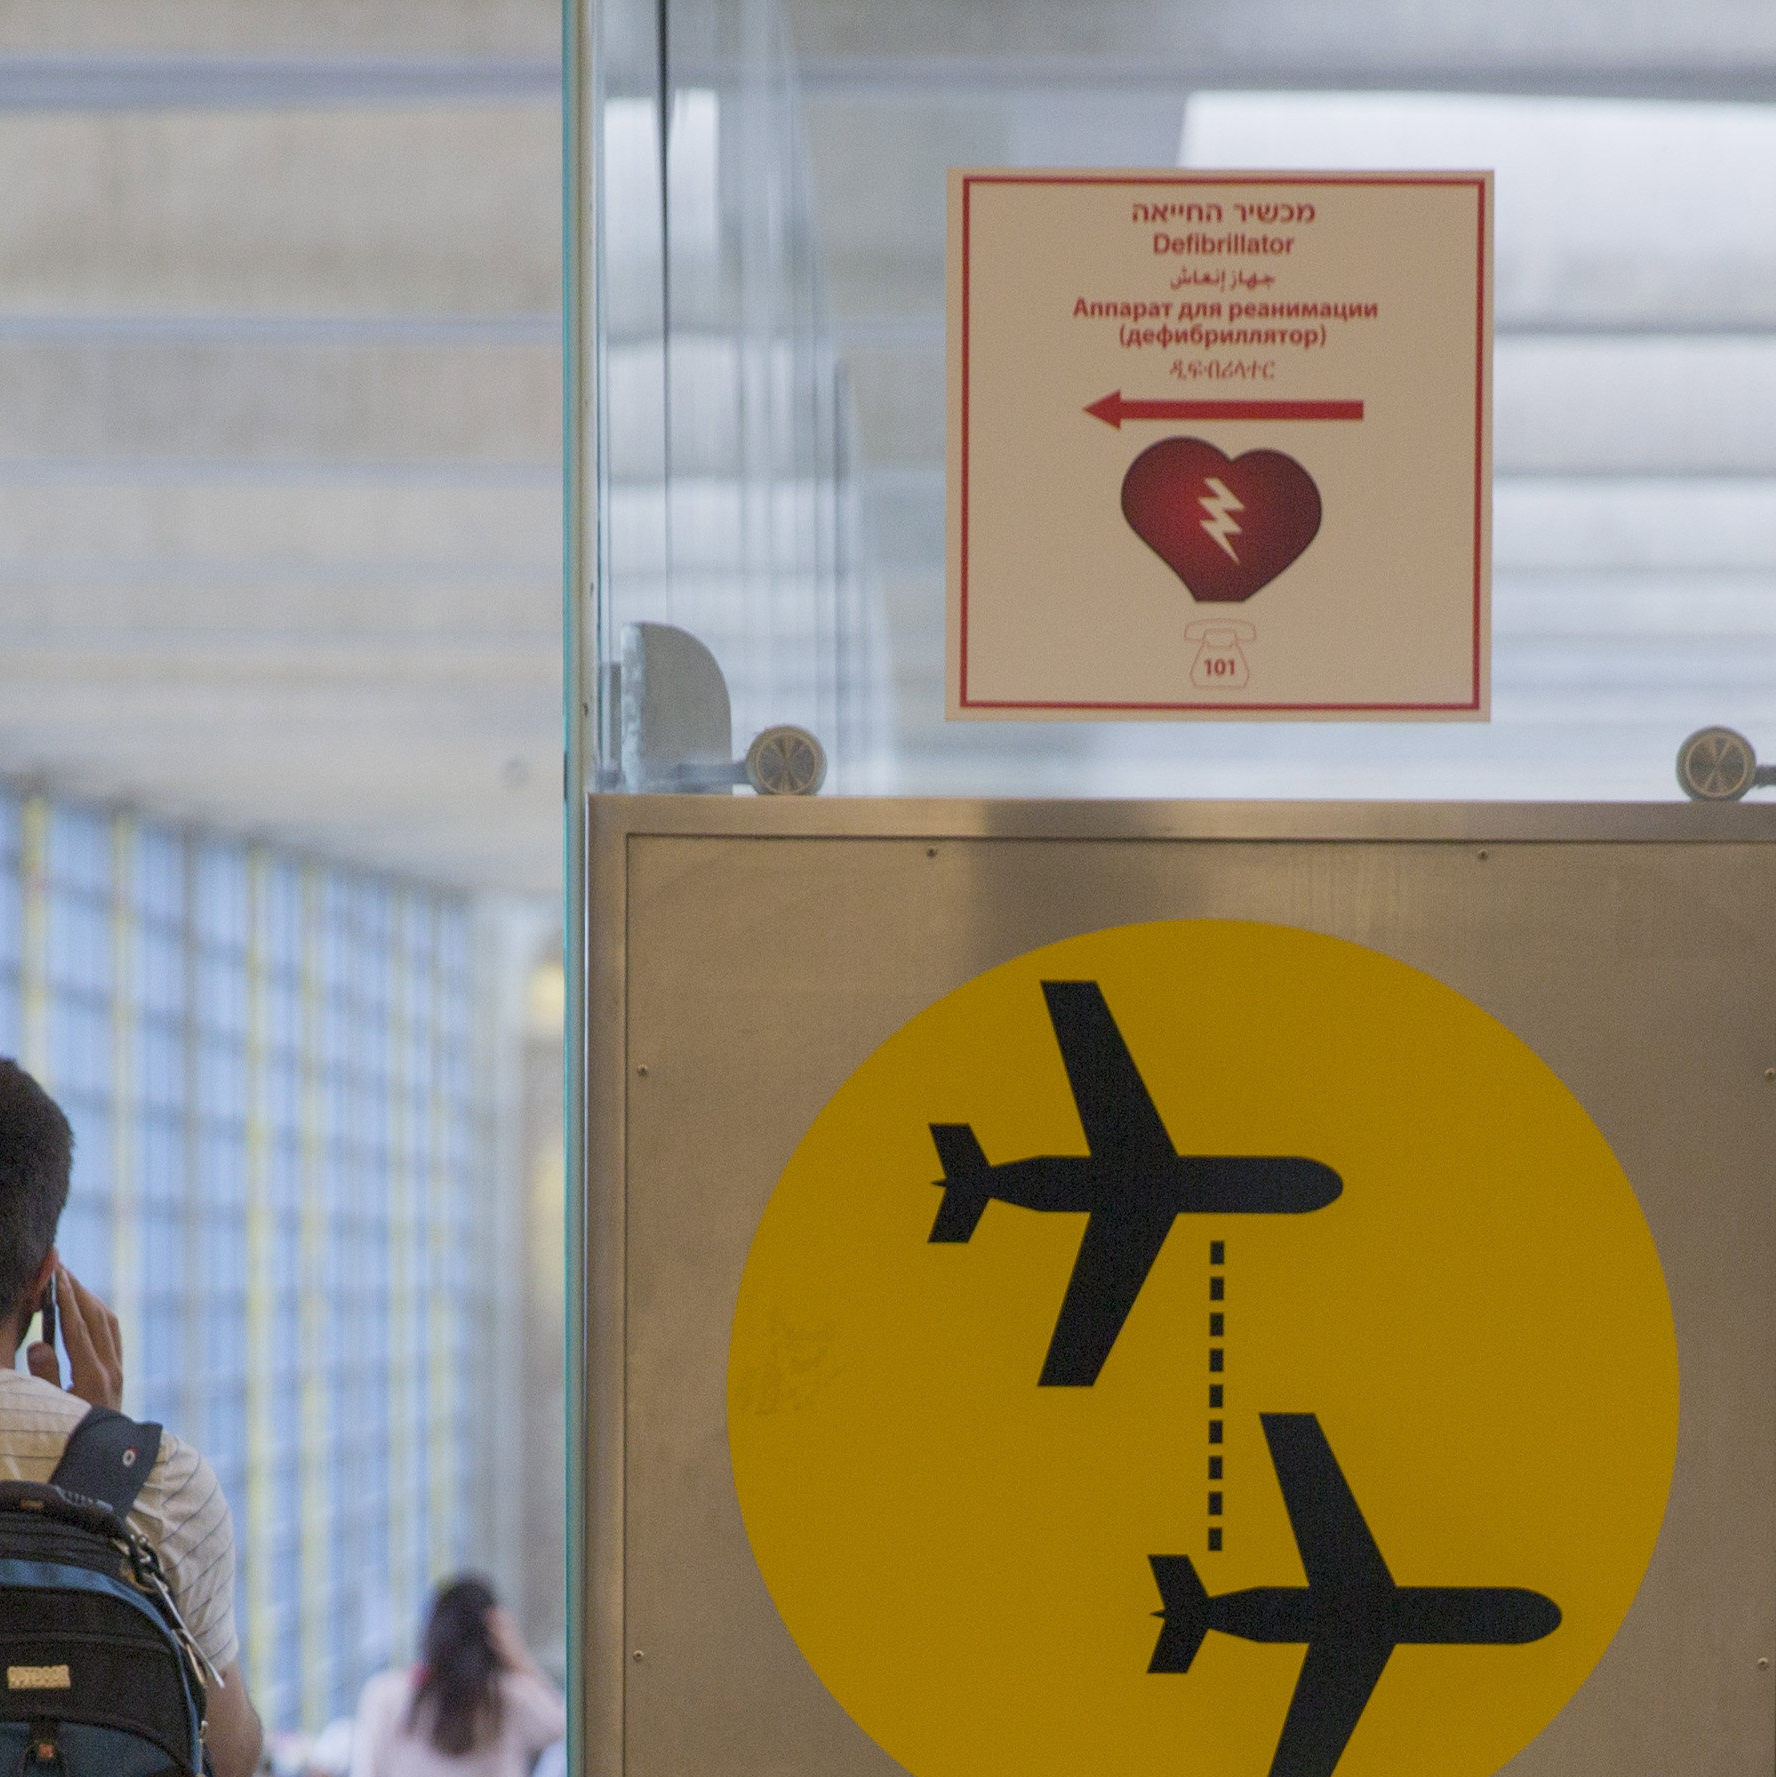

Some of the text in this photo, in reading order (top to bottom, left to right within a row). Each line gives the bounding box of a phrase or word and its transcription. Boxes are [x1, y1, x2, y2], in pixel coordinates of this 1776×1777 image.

[1131, 202, 1316, 223] מכשיר החייאה
[1152, 232, 1294, 255] Defibrillator
[1230, 267, 1275, 291] جهاز
[1072, 296, 1379, 323] Аппарат для реанимации
[1119, 322, 1327, 350] (дефибриллятор)
[1204, 658, 1236, 676] 101
